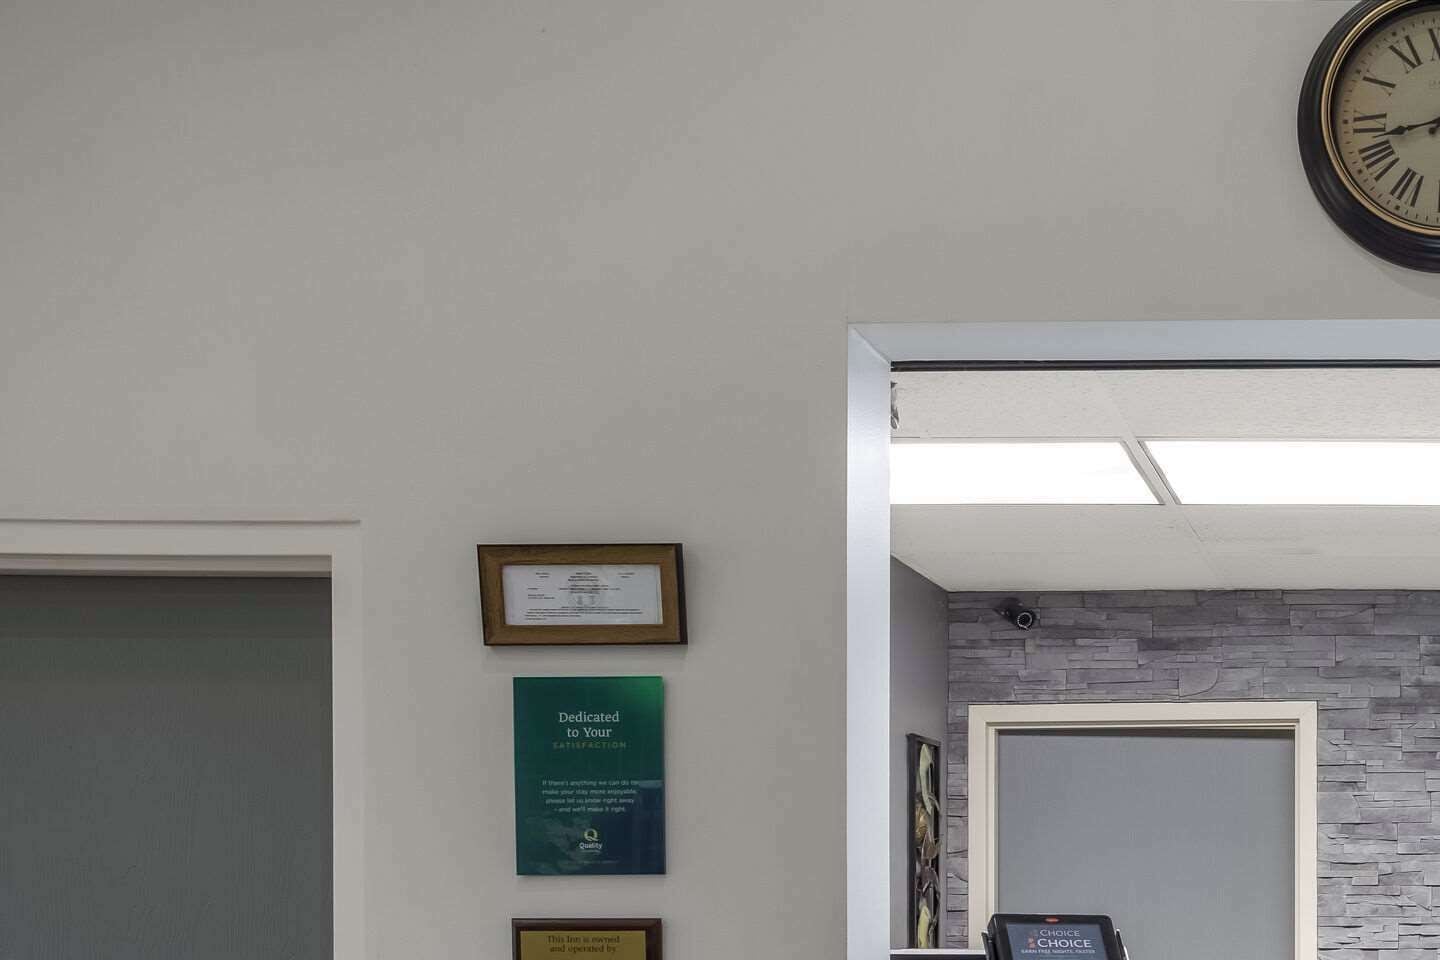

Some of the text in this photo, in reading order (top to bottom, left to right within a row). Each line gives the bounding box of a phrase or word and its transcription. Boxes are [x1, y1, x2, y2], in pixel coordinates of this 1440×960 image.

[1388, 36, 1424, 74] XI
[1358, 140, 1400, 182] VIII
[1389, 168, 1424, 207] VII
[559, 711, 620, 722] Dedicated
[567, 727, 612, 737] to Your
[547, 935, 565, 943] This
[567, 935, 581, 943] Inn
[592, 935, 620, 943] owned
[1038, 939, 1092, 948] CHOICE
[568, 944, 604, 954] operated
[607, 944, 616, 954] by
